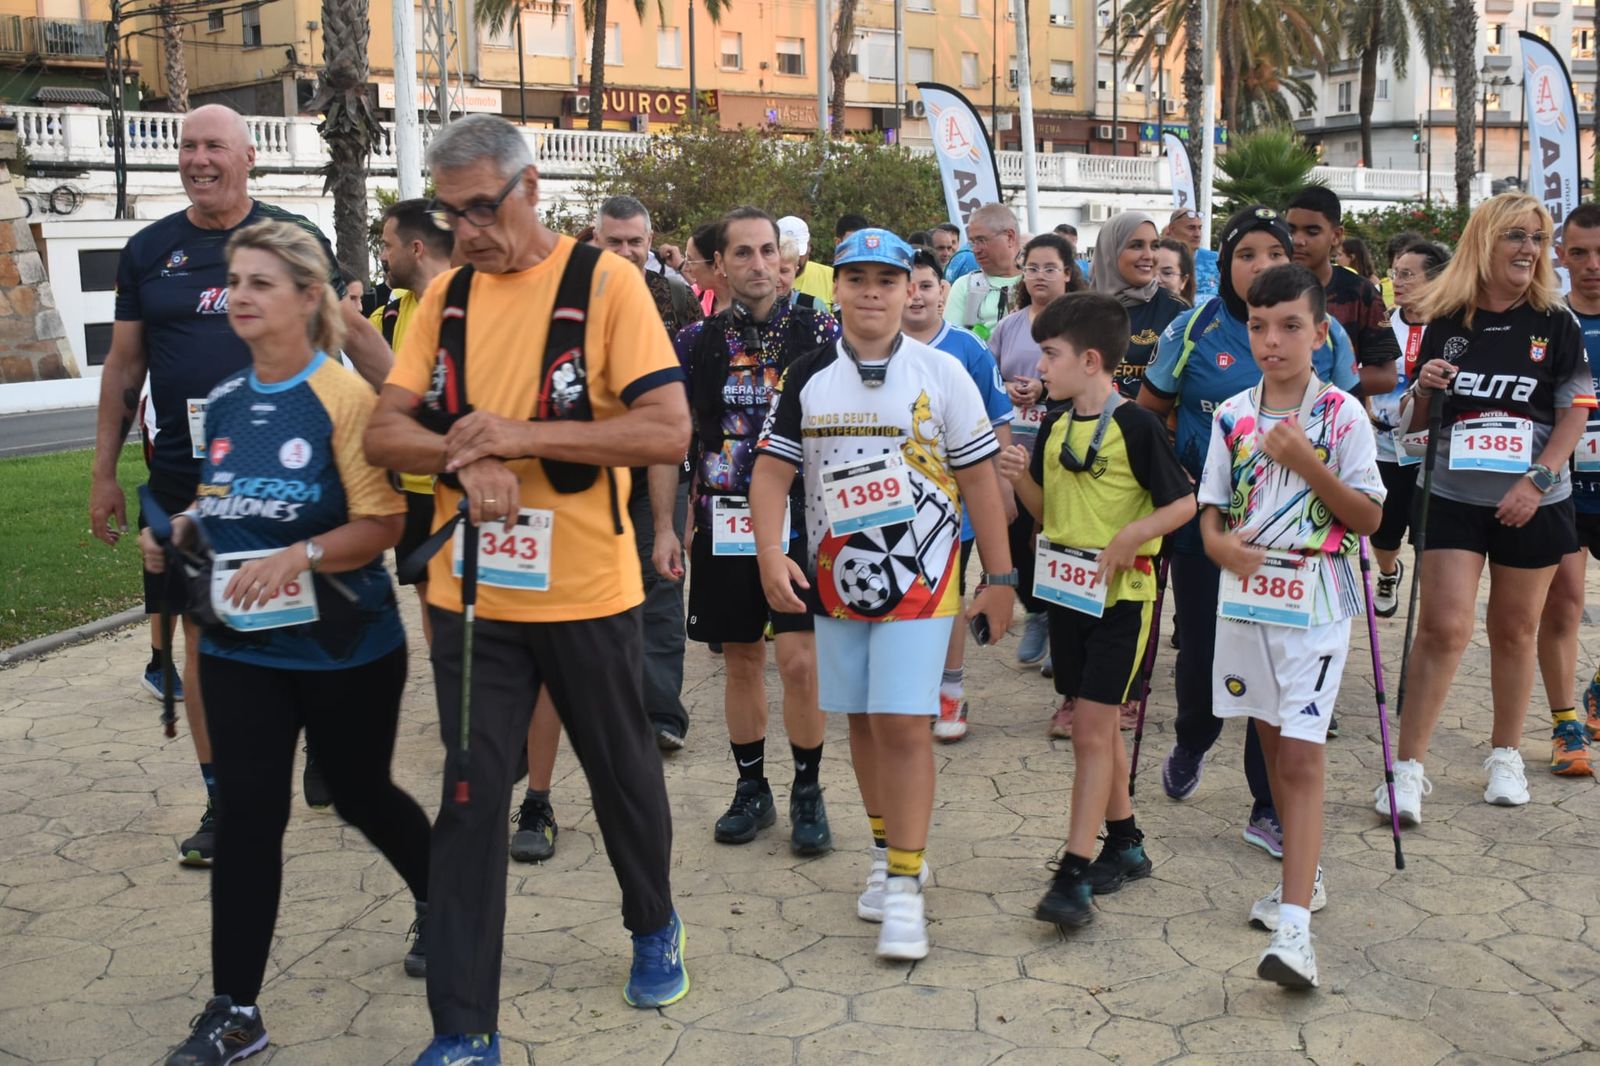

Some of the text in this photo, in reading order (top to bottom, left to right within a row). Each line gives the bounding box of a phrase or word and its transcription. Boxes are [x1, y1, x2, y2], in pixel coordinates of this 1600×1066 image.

[1464, 435, 1523, 452] 1385
[836, 477, 901, 509] 1389
[1047, 560, 1099, 589] 1387
[1237, 575, 1304, 600] 1386
[1314, 655, 1332, 692] 1
